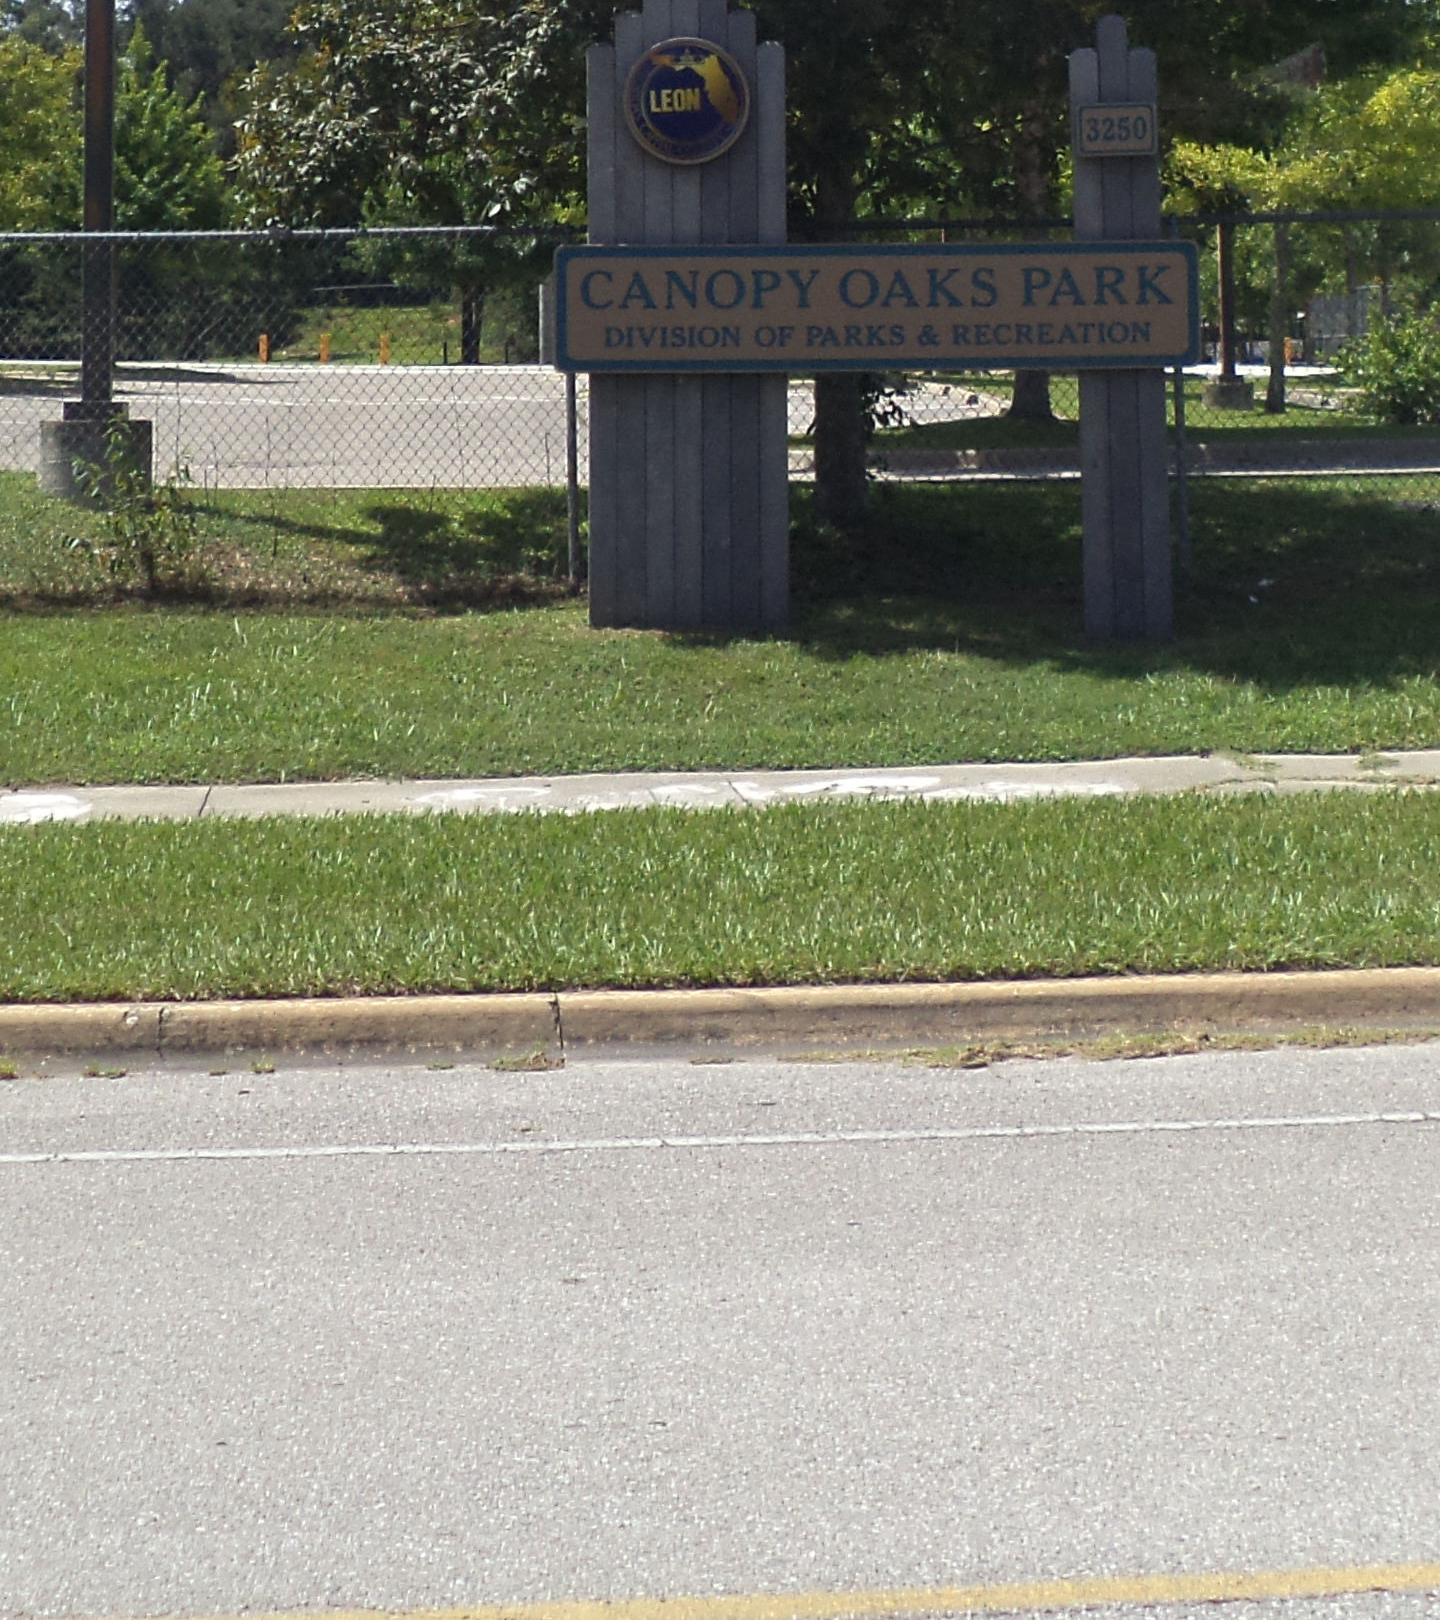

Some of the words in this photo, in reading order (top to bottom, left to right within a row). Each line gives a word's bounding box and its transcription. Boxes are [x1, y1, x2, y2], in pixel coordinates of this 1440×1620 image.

[649, 88, 701, 113] LEON
[1086, 115, 1147, 142] 3250
[580, 268, 819, 310] CANOPY
[838, 267, 999, 309] OAKS
[1020, 265, 1174, 306] PARK
[604, 325, 740, 348] DIVISION
[754, 325, 795, 348] OF
[806, 325, 906, 347] PARKS
[916, 324, 940, 346] &
[952, 321, 1152, 346] RECREATION
